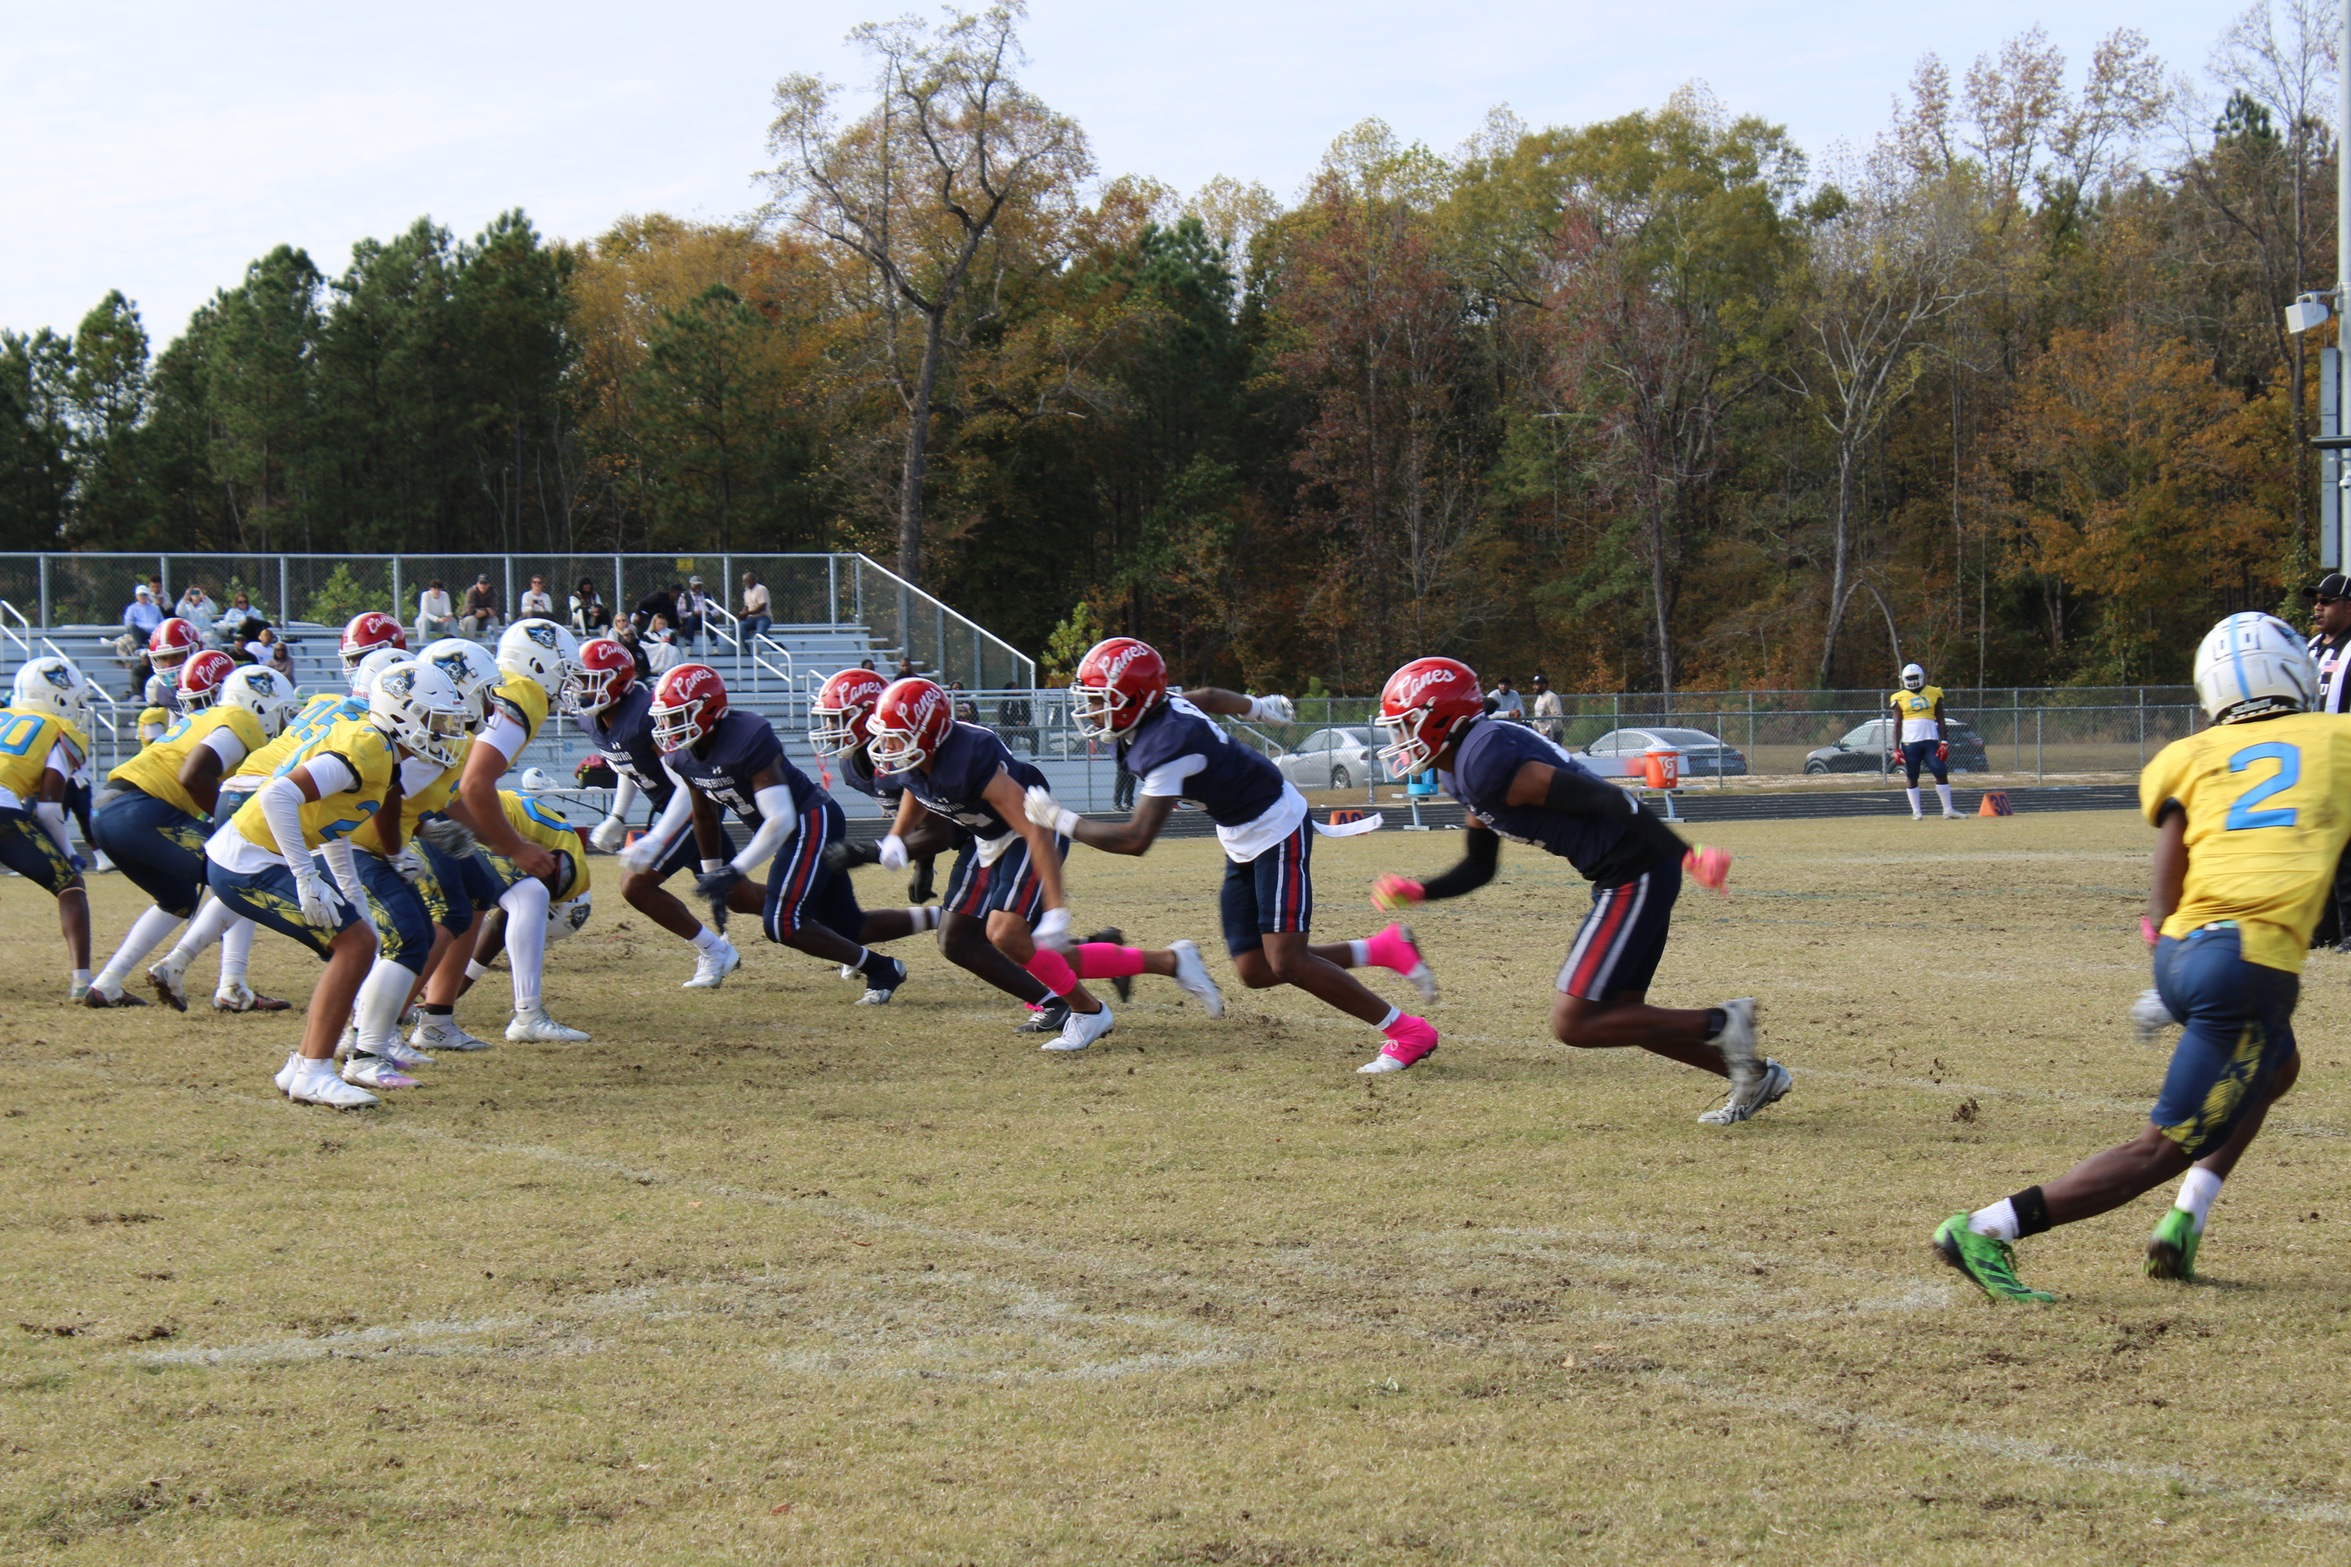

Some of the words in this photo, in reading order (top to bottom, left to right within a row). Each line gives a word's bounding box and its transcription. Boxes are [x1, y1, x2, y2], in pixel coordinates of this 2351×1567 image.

[195, 654, 228, 686] Canes
[672, 668, 714, 701] Canes
[837, 681, 884, 707] Canes
[1393, 668, 1457, 709] Canes
[1909, 696, 1930, 713] 51
[2319, 683, 2330, 696] U
[896, 686, 942, 732] Canes
[2225, 741, 2301, 832] 2
[1988, 793, 2014, 816] 30
